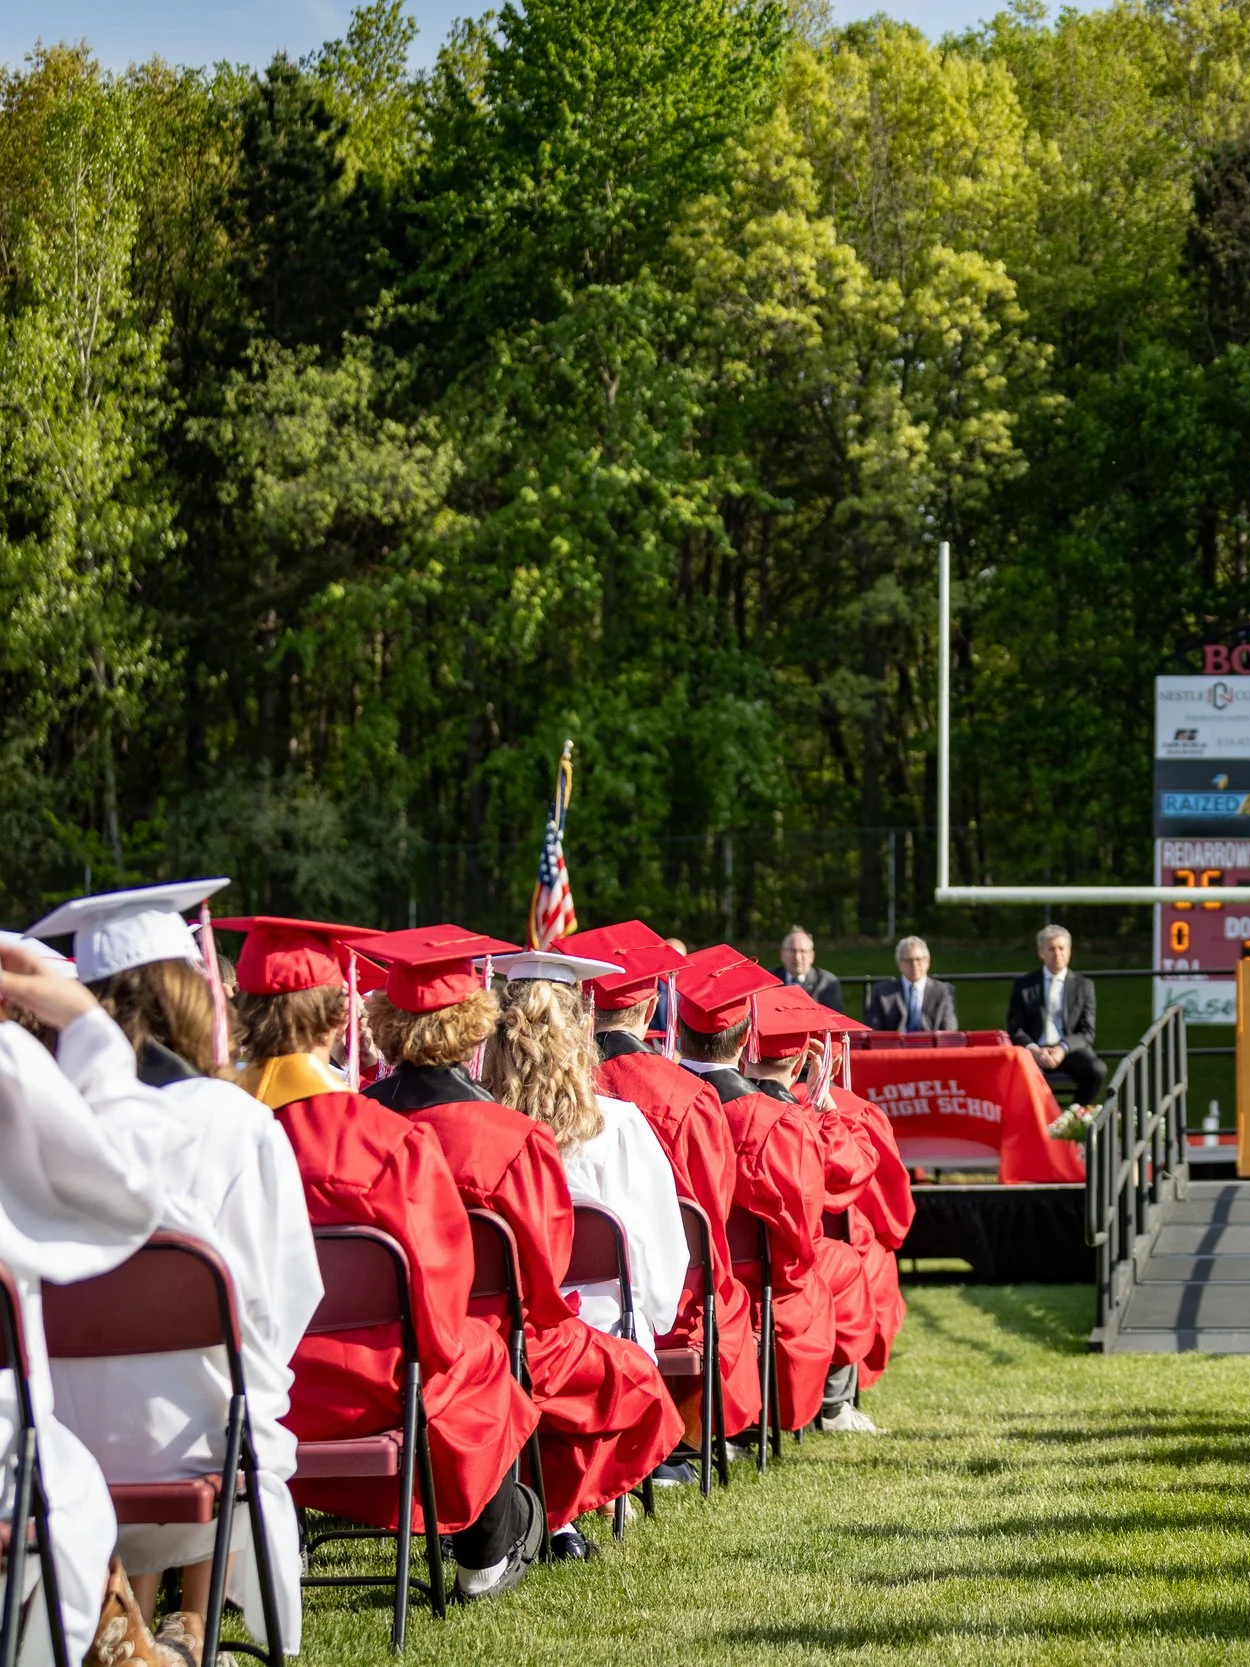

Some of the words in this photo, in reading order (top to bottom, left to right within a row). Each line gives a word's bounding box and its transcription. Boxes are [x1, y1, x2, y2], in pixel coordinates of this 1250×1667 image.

[1166, 795, 1240, 812] RAIZED
[1170, 920, 1191, 953] 0
[867, 1079, 966, 1102] LOWELL
